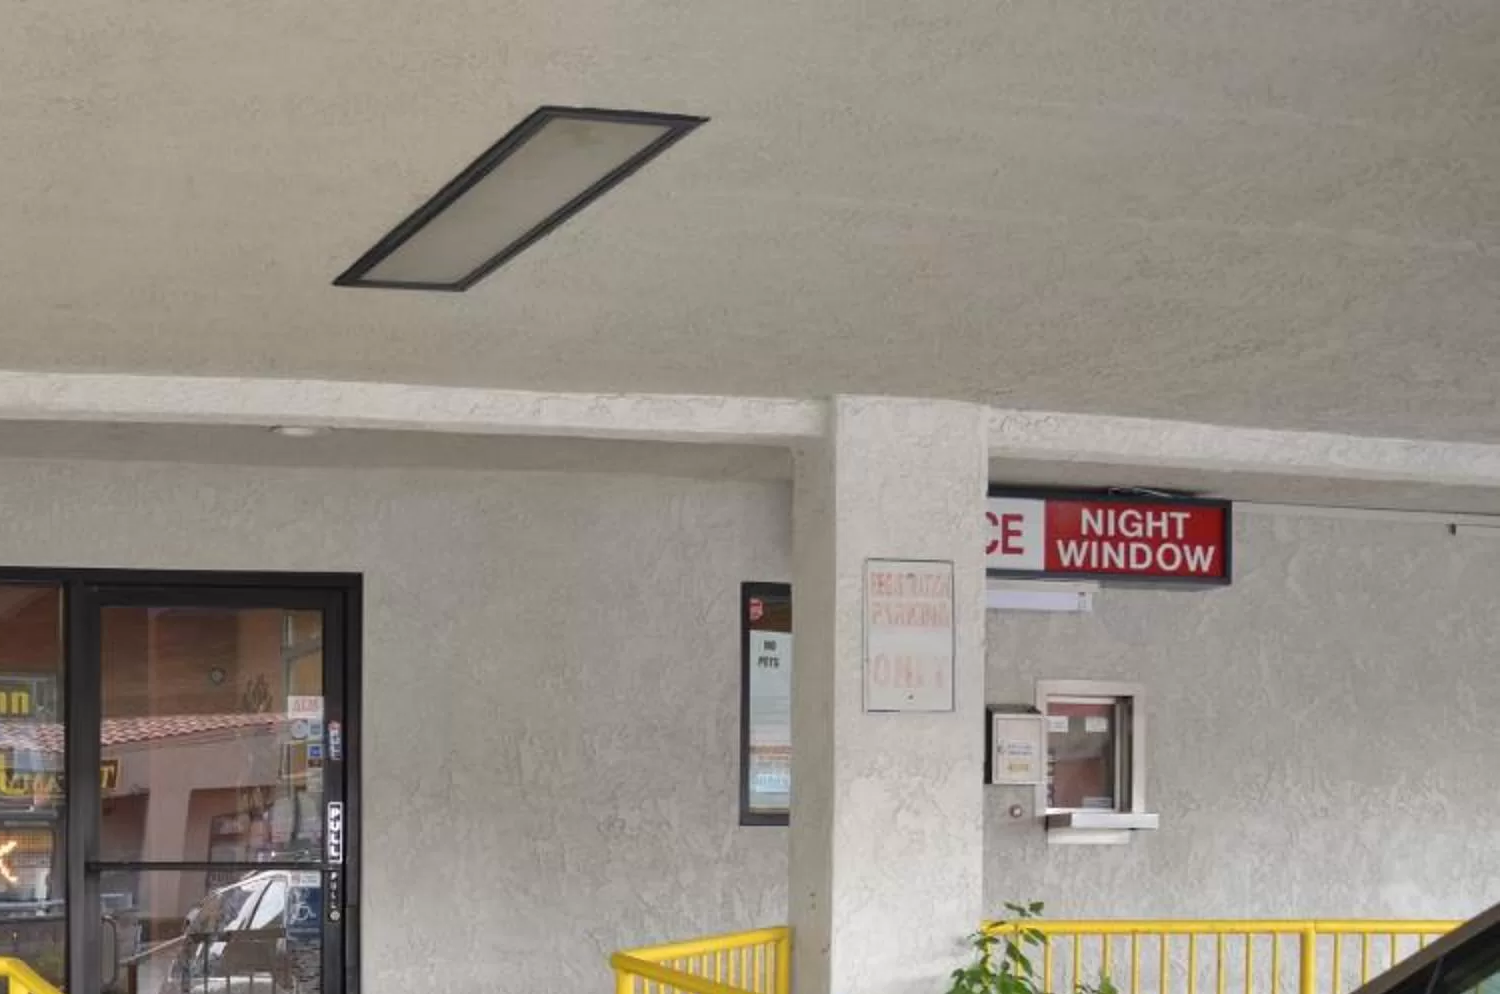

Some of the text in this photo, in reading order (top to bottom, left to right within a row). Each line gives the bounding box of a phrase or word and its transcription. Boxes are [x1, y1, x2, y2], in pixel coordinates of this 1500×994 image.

[1081, 508, 1191, 540] NIGHT
[1057, 540, 1215, 573] WINDOW
[330, 807, 340, 858] PULL
